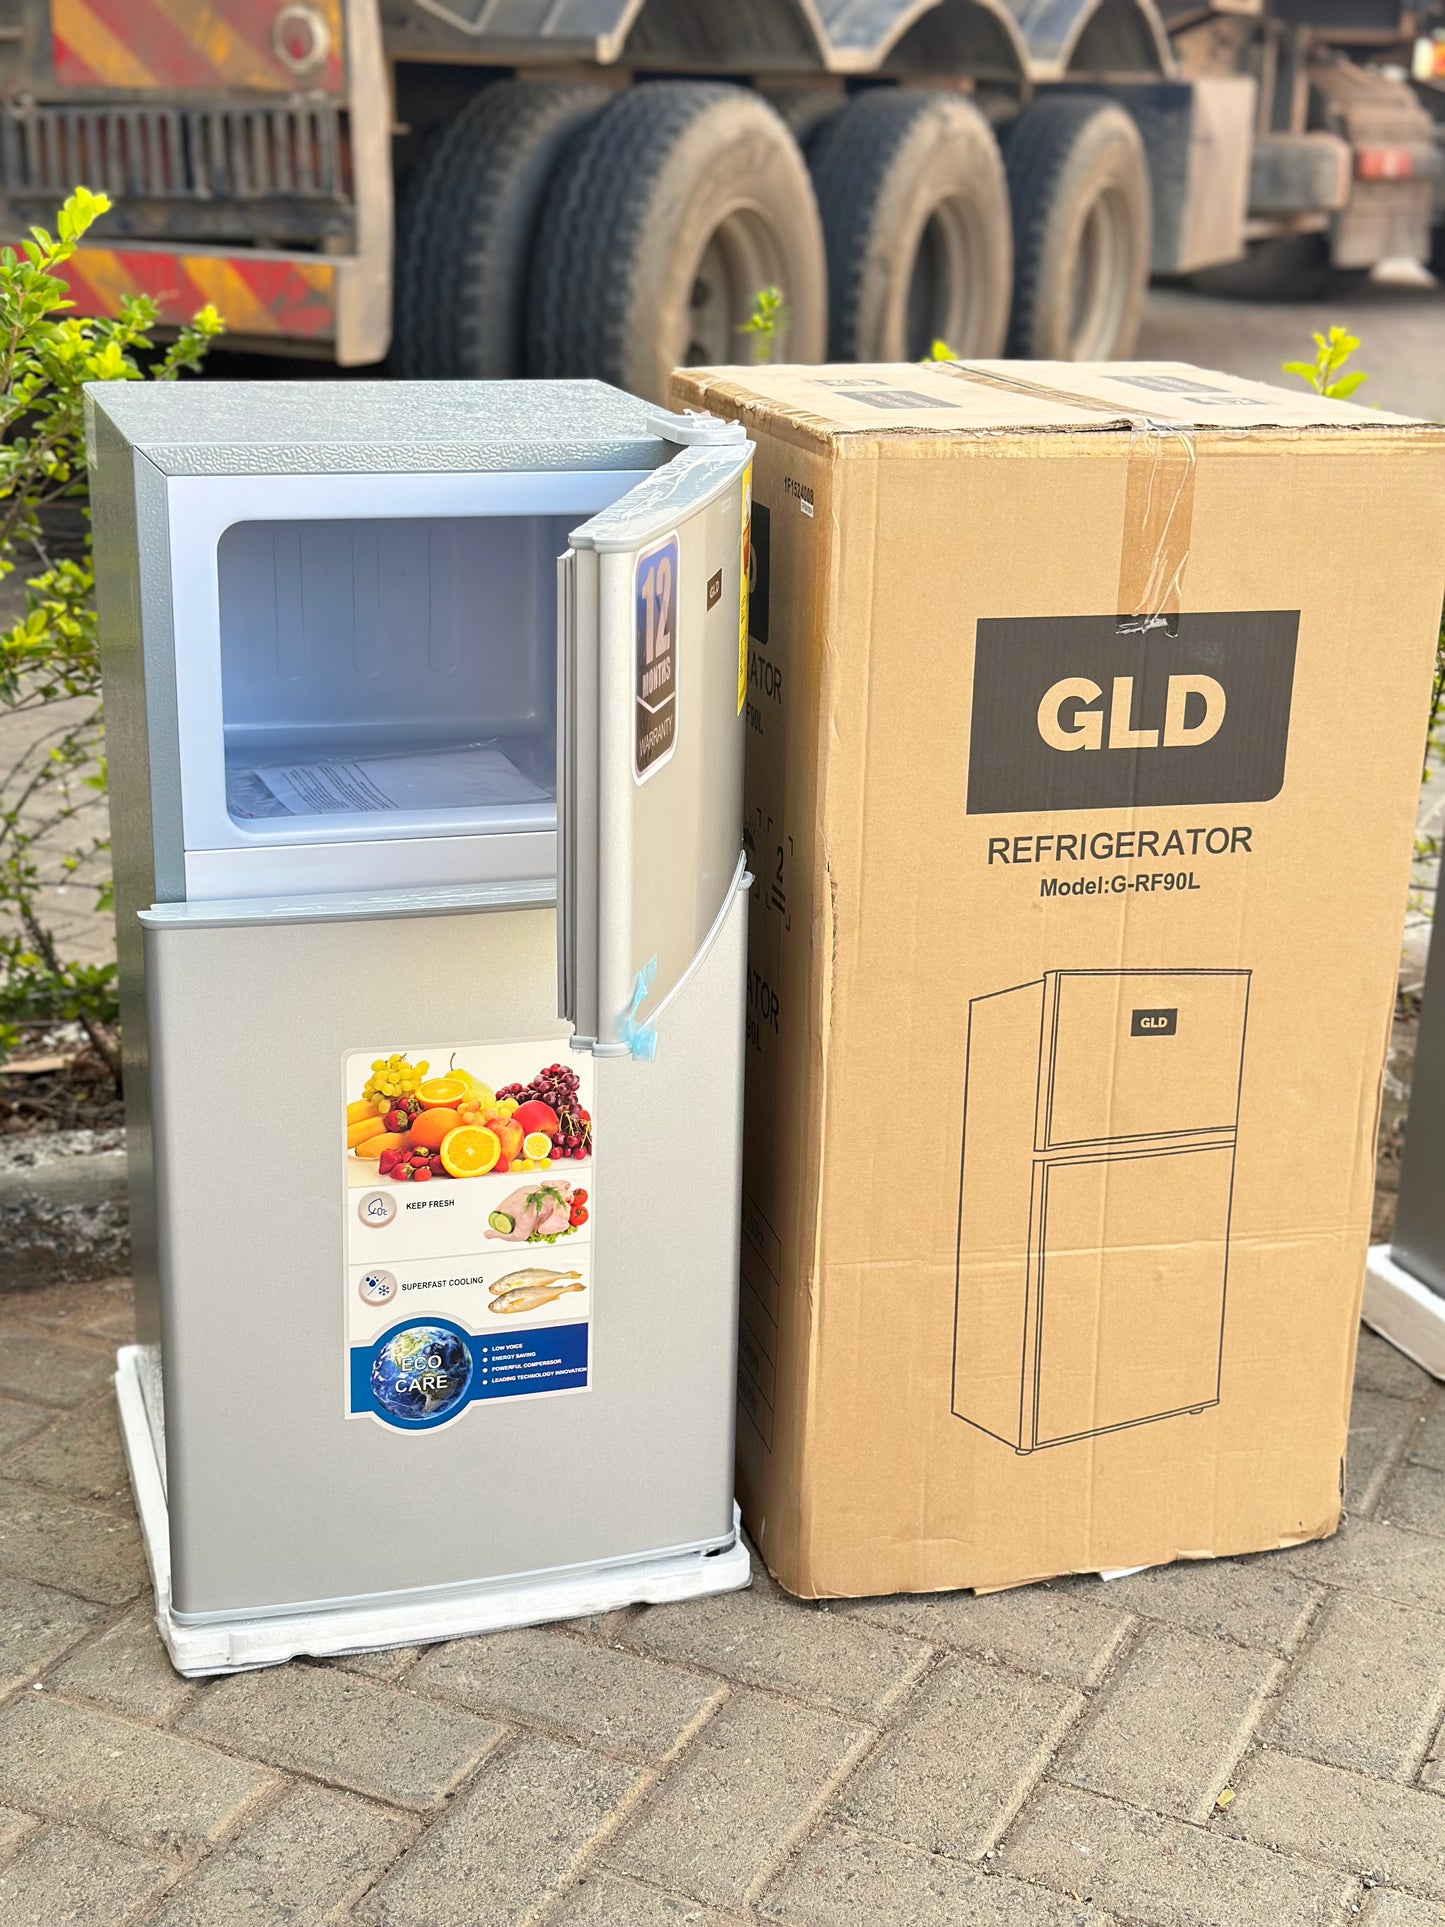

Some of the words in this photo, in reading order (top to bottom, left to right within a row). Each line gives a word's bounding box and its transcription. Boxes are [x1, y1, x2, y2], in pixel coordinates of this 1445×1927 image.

[709, 580, 720, 599] GLD
[641, 556, 671, 665] 12
[642, 655, 671, 699] MONTHS
[1037, 673, 1226, 752] GLD
[639, 714, 673, 757] WARRANTY
[987, 826, 1253, 865] REFRIGERATOR
[1039, 871, 1201, 897] Model:G-RF90L
[1140, 1016, 1168, 1029] GLD
[406, 1202, 427, 1210] KEEP
[428, 1199, 455, 1208] FRESH
[401, 1280, 446, 1290] SUPERFAST
[448, 1276, 484, 1286] COOLING
[401, 1355, 442, 1372] ECO
[491, 1354, 515, 1362] ENERGY
[515, 1351, 537, 1360] SAVING
[491, 1363, 523, 1372] POWERFUL
[491, 1376, 517, 1384] LEADING
[517, 1370, 555, 1381] TECHNOLOGY
[554, 1366, 588, 1376] INNOVATION
[395, 1375, 448, 1393] CARE
